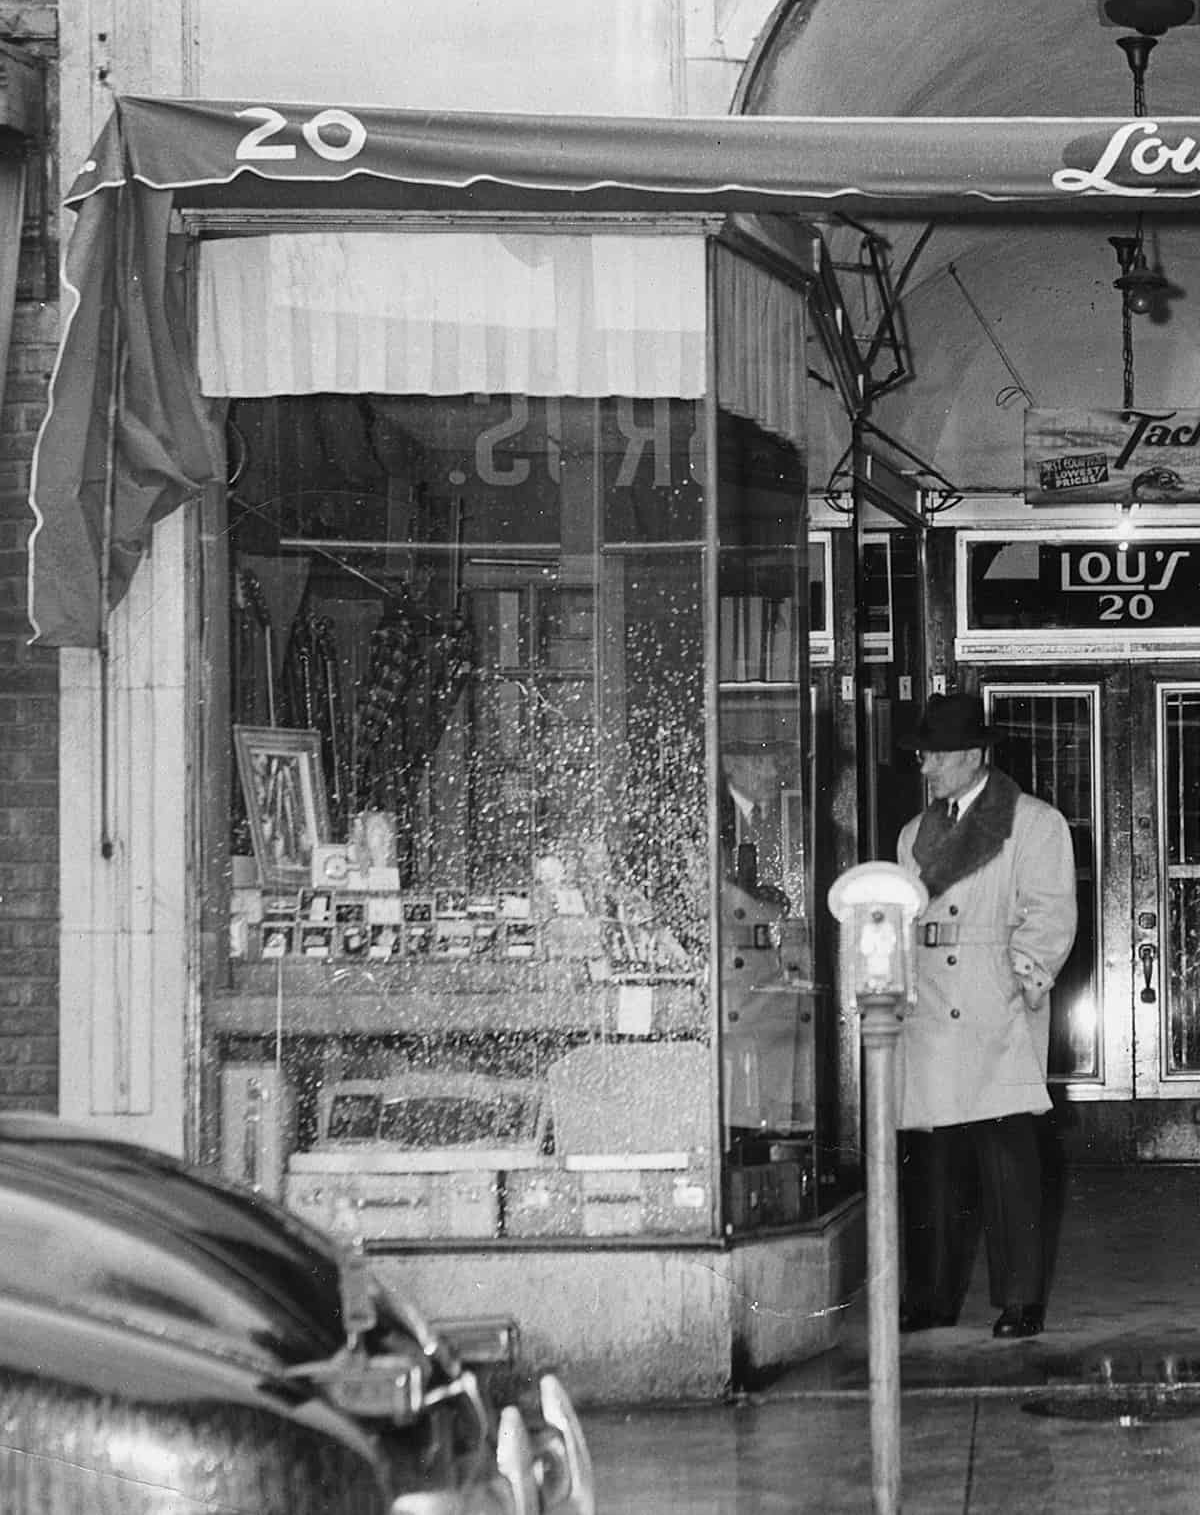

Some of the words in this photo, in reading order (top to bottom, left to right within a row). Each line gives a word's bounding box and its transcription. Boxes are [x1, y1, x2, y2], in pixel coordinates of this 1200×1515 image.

[234, 107, 368, 161] 20
[1061, 550, 1190, 591] LOU'S
[1099, 594, 1154, 621] 20
